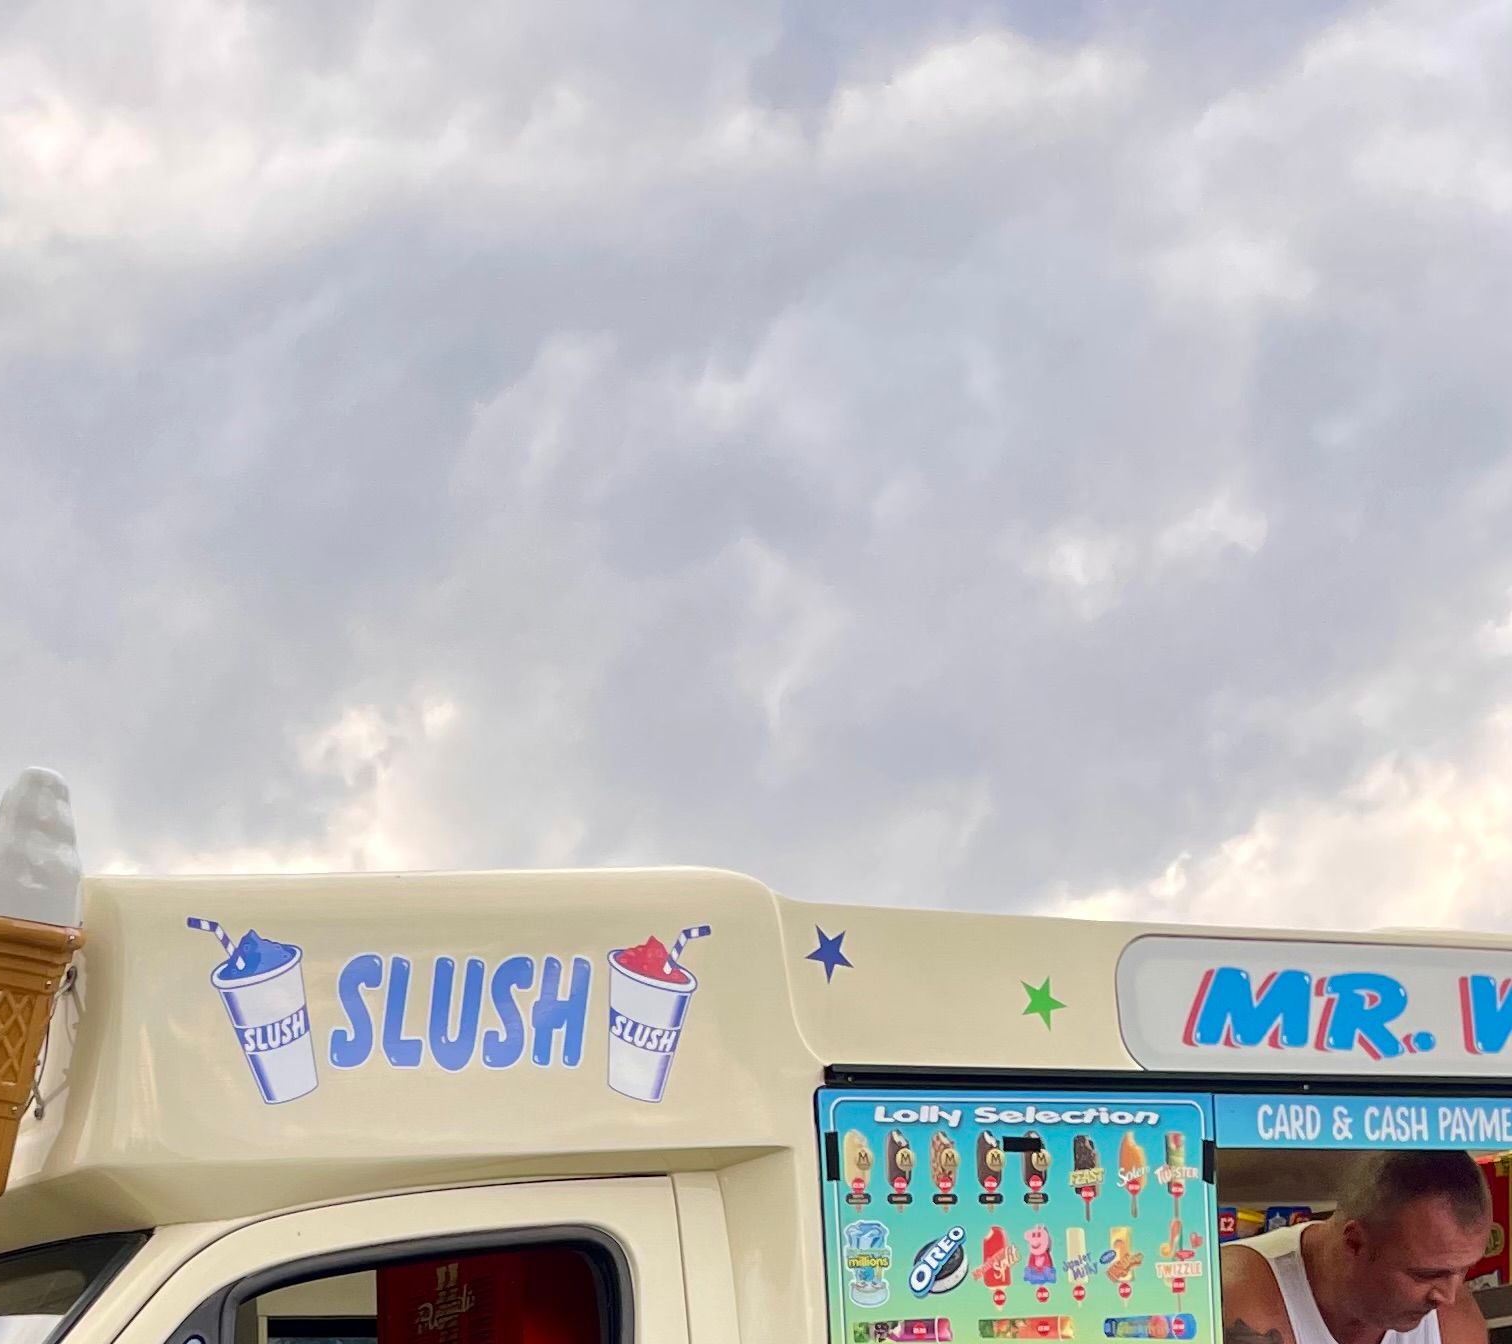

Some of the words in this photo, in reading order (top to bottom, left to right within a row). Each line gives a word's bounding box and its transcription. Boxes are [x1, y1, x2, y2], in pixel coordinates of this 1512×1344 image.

[244, 1009, 306, 1053] SLUSH
[328, 953, 592, 1072] SLUSH
[610, 1016, 676, 1053] SLUSH
[1183, 967, 1436, 1061] MR.
[874, 1105, 962, 1128] Lolly
[974, 1106, 1160, 1125] Selection
[1257, 1104, 1321, 1141] CARD
[1332, 1105, 1353, 1141] &
[1364, 1106, 1429, 1142] CASH
[911, 1227, 964, 1292] OREO
